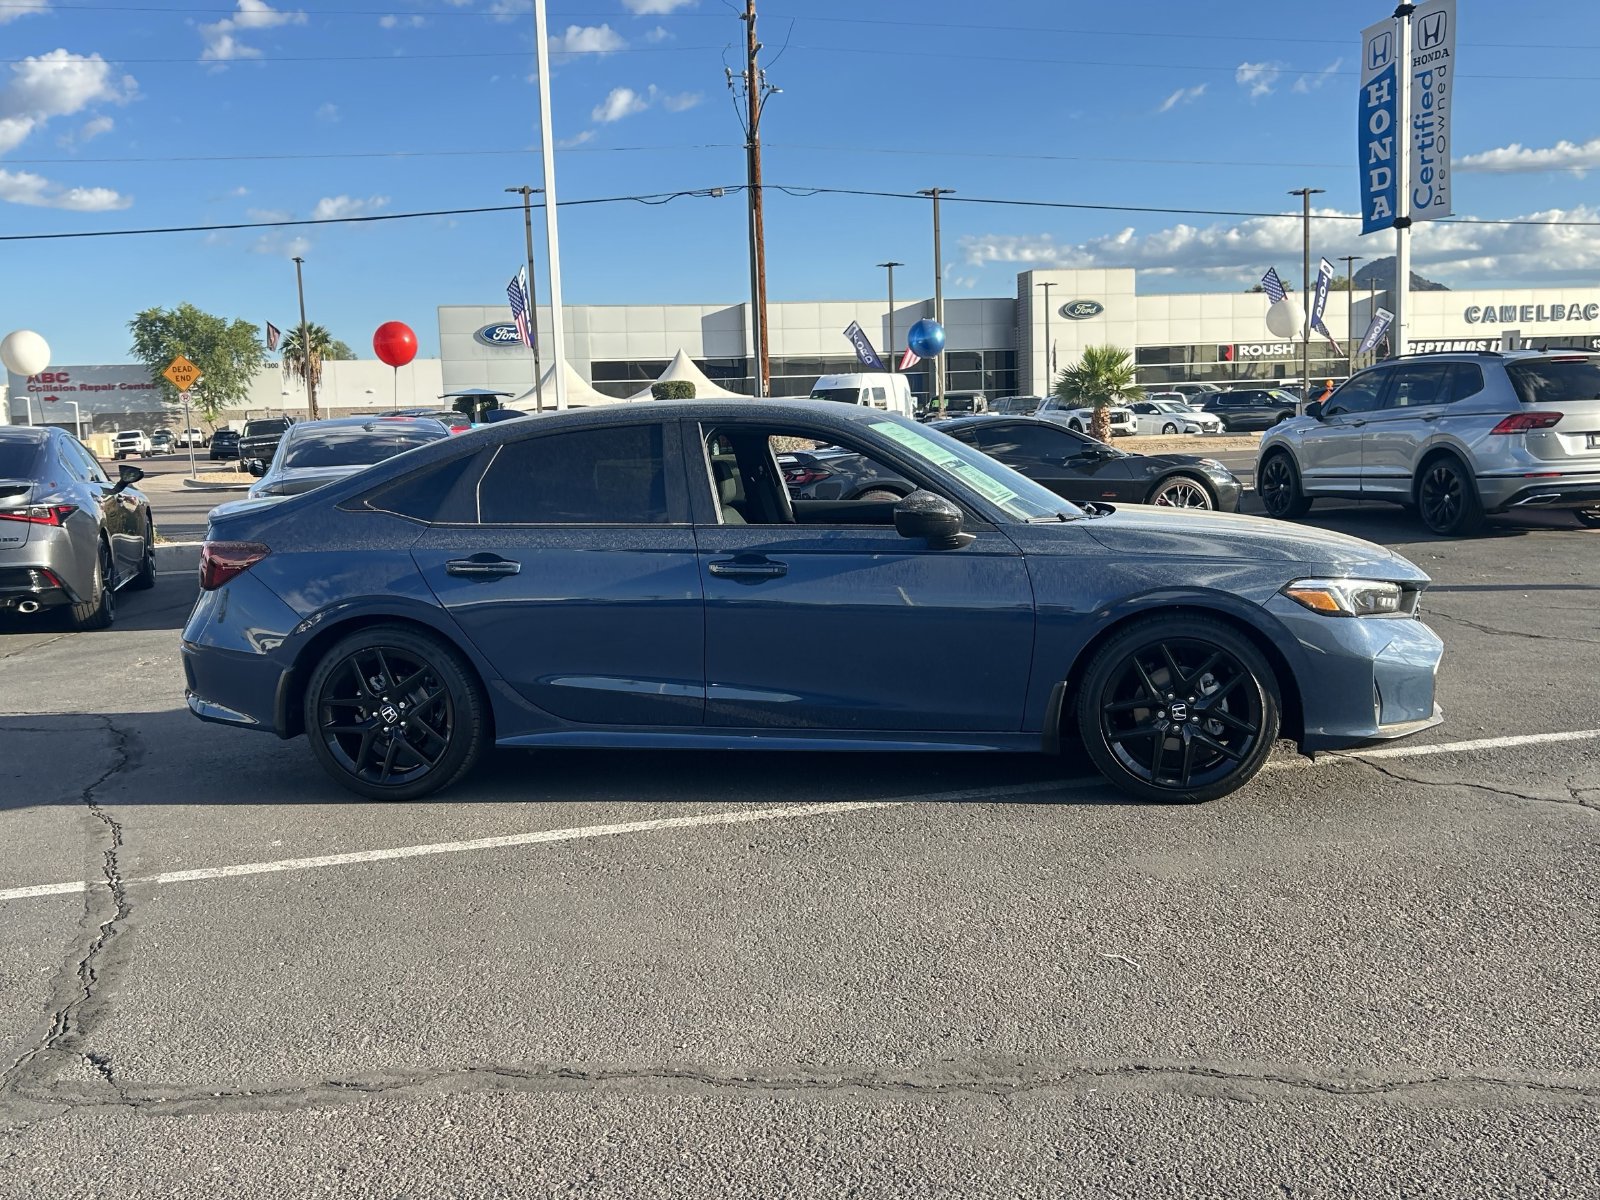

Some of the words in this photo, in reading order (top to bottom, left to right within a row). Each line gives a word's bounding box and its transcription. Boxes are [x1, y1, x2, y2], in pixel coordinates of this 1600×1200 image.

[1413, 49, 1450, 67] HONDA
[1413, 69, 1434, 209] Certified
[1434, 64, 1447, 206] Pre-Owned
[1367, 78, 1392, 221] HONDA
[1075, 303, 1098, 314] Ford
[853, 334, 873, 364] FORD
[1239, 343, 1295, 356] ROUSH
[1408, 340, 1487, 354] CEPTAMOS
[172, 365, 193, 373] DEAD
[26, 372, 70, 384] ABC
[27, 385, 76, 393] Collision
[79, 384, 115, 392] Repair
[119, 382, 158, 391] Center
